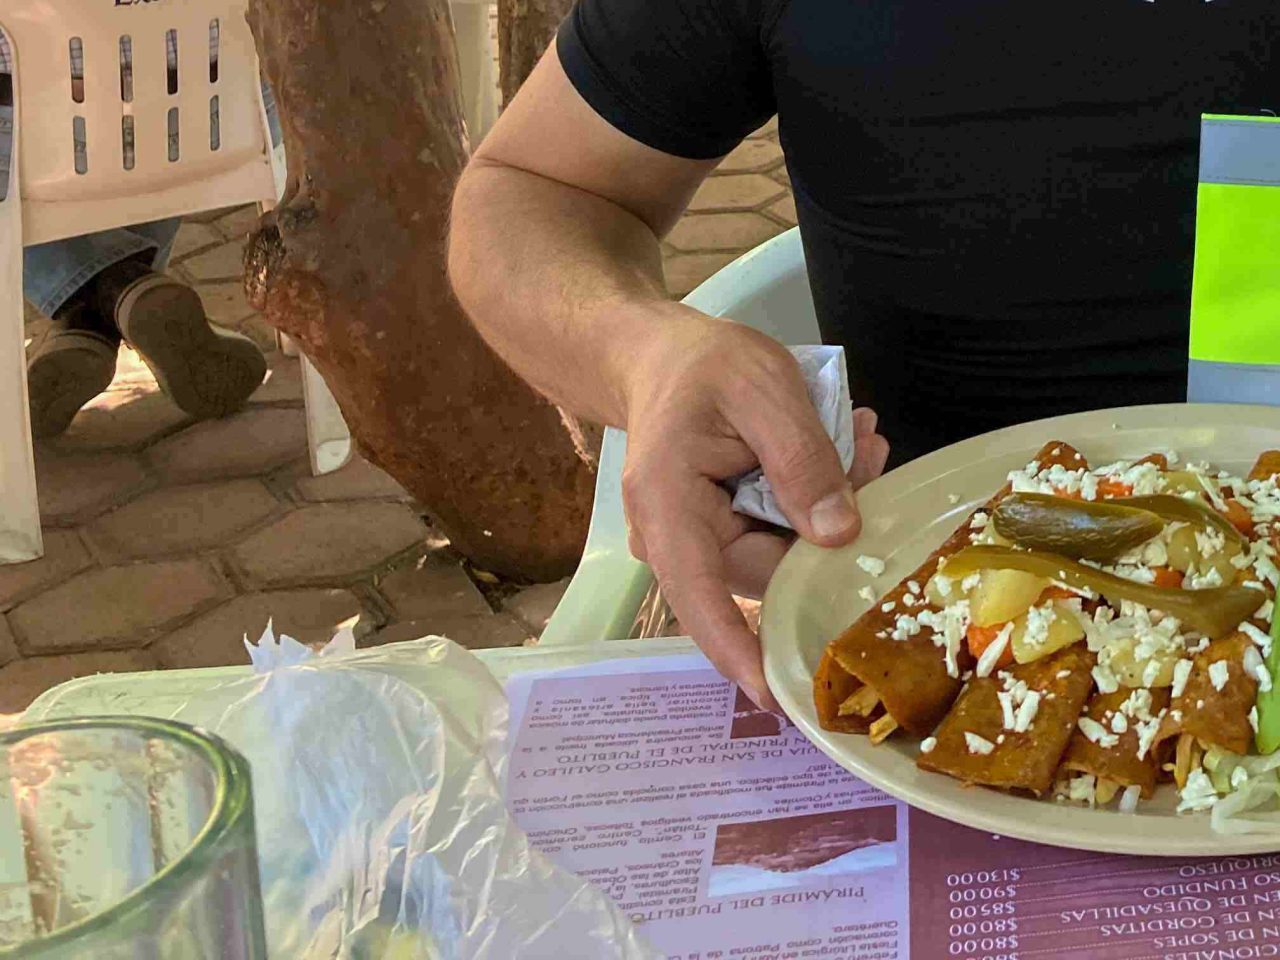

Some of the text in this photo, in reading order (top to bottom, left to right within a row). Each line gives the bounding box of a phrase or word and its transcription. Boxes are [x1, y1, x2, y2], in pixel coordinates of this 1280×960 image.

[646, 748, 665, 757] EL
[670, 745, 693, 755] DE
[700, 738, 788, 753] PRINCIPAL
[557, 749, 641, 764] PUEBLITO
[721, 751, 756, 762] SAN
[760, 749, 783, 759] DE
[532, 763, 611, 778] GALILEO
[615, 754, 715, 772] FRANCISCO
[514, 770, 528, 780] Y
[946, 867, 1020, 887] $130.00
[948, 883, 1017, 903] $90.00
[1142, 875, 1248, 898] FUNDIDO
[727, 896, 765, 910] DEL
[770, 886, 865, 906] PIRÁMIDE
[1217, 894, 1245, 909] DE
[948, 900, 1016, 920] $85.00
[1059, 896, 1211, 924] QUESADILLAS
[1221, 910, 1250, 925] DE
[948, 917, 1019, 938] $80.00
[1099, 914, 1215, 937] GORDITAS
[1153, 931, 1219, 949] SOPES
[1224, 927, 1254, 942] DE
[948, 934, 1019, 955] $80.00
